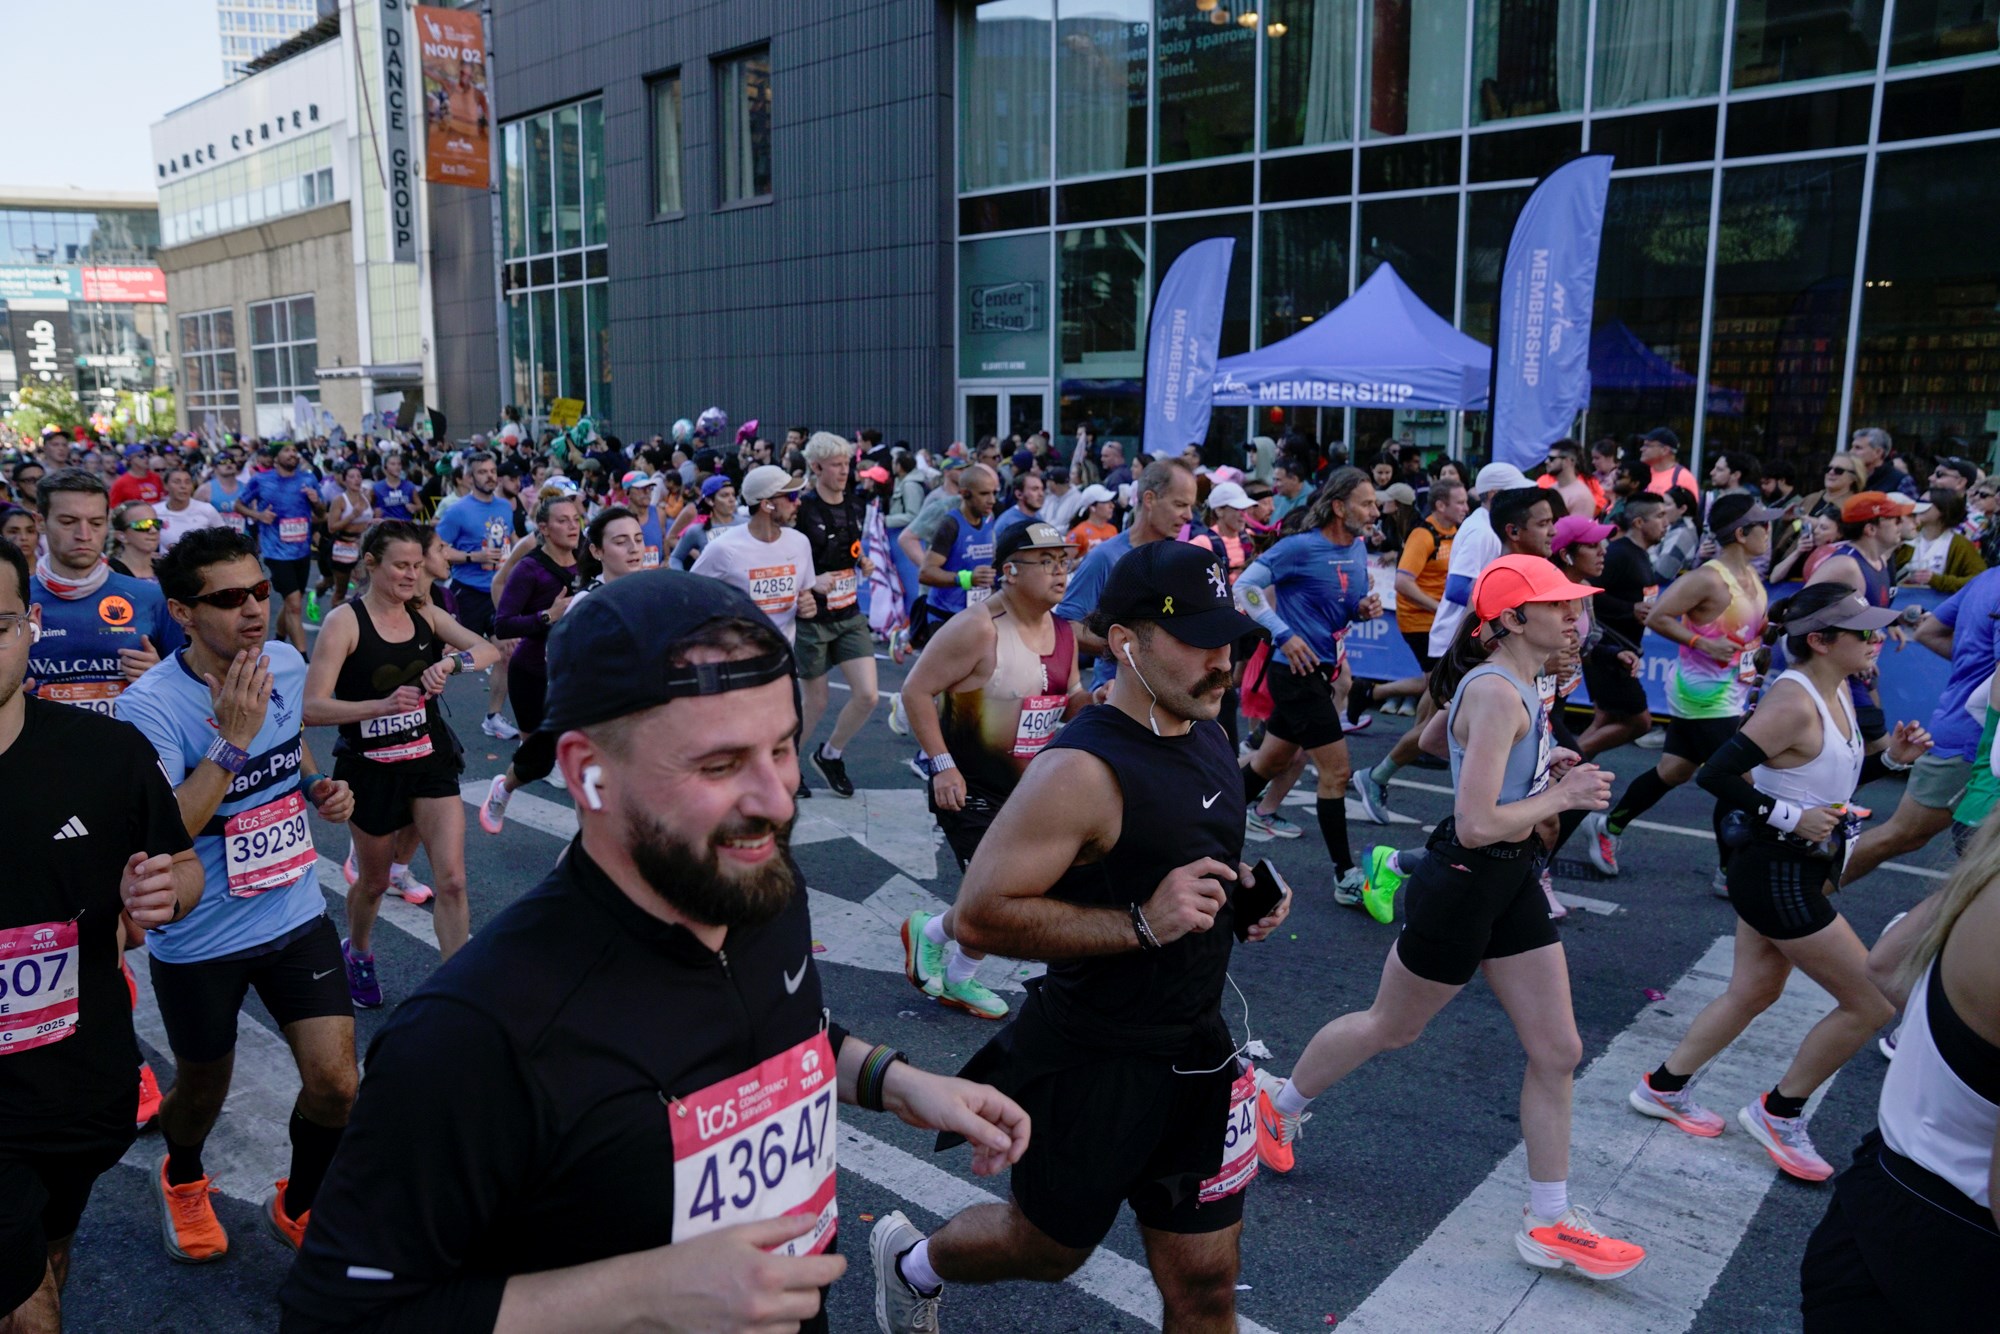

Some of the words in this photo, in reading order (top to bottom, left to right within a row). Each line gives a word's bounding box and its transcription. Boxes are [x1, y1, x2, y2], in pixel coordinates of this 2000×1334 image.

[1133, 23, 1147, 37] so
[1158, 15, 1186, 32] long
[423, 42, 459, 60] NOV
[462, 47, 482, 64] 02
[1158, 38, 1192, 55] noisy
[1196, 28, 1255, 51] sparrows
[387, 28, 403, 130] DANCE
[158, 144, 216, 178] DANCE
[231, 103, 319, 151] CENTER
[393, 149, 410, 248] GROUP
[971, 289, 1024, 308] Center
[971, 311, 1024, 330] Fiction
[1523, 249, 1549, 387] MEMBERSHIP
[1163, 309, 1187, 422] MEMBERSHIP
[1259, 380, 1413, 403] MEMBERSHIP
[1040, 528, 1058, 537] NYC
[753, 577, 793, 594] 42852
[41, 628, 67, 638] xime
[51, 687, 71, 698] tcs
[238, 816, 259, 830] tcs
[233, 815, 305, 863] 39239
[31, 941, 58, 950] TATA
[3, 1033, 13, 1041] C
[37, 1018, 66, 1034] 2025
[737, 1080, 760, 1097] TATA
[800, 1070, 824, 1090] TATA
[739, 1076, 789, 1110] CONSULTANCY
[696, 1098, 738, 1140] tcs
[741, 1098, 773, 1121] SERVICES
[689, 1089, 830, 1222] 43647
